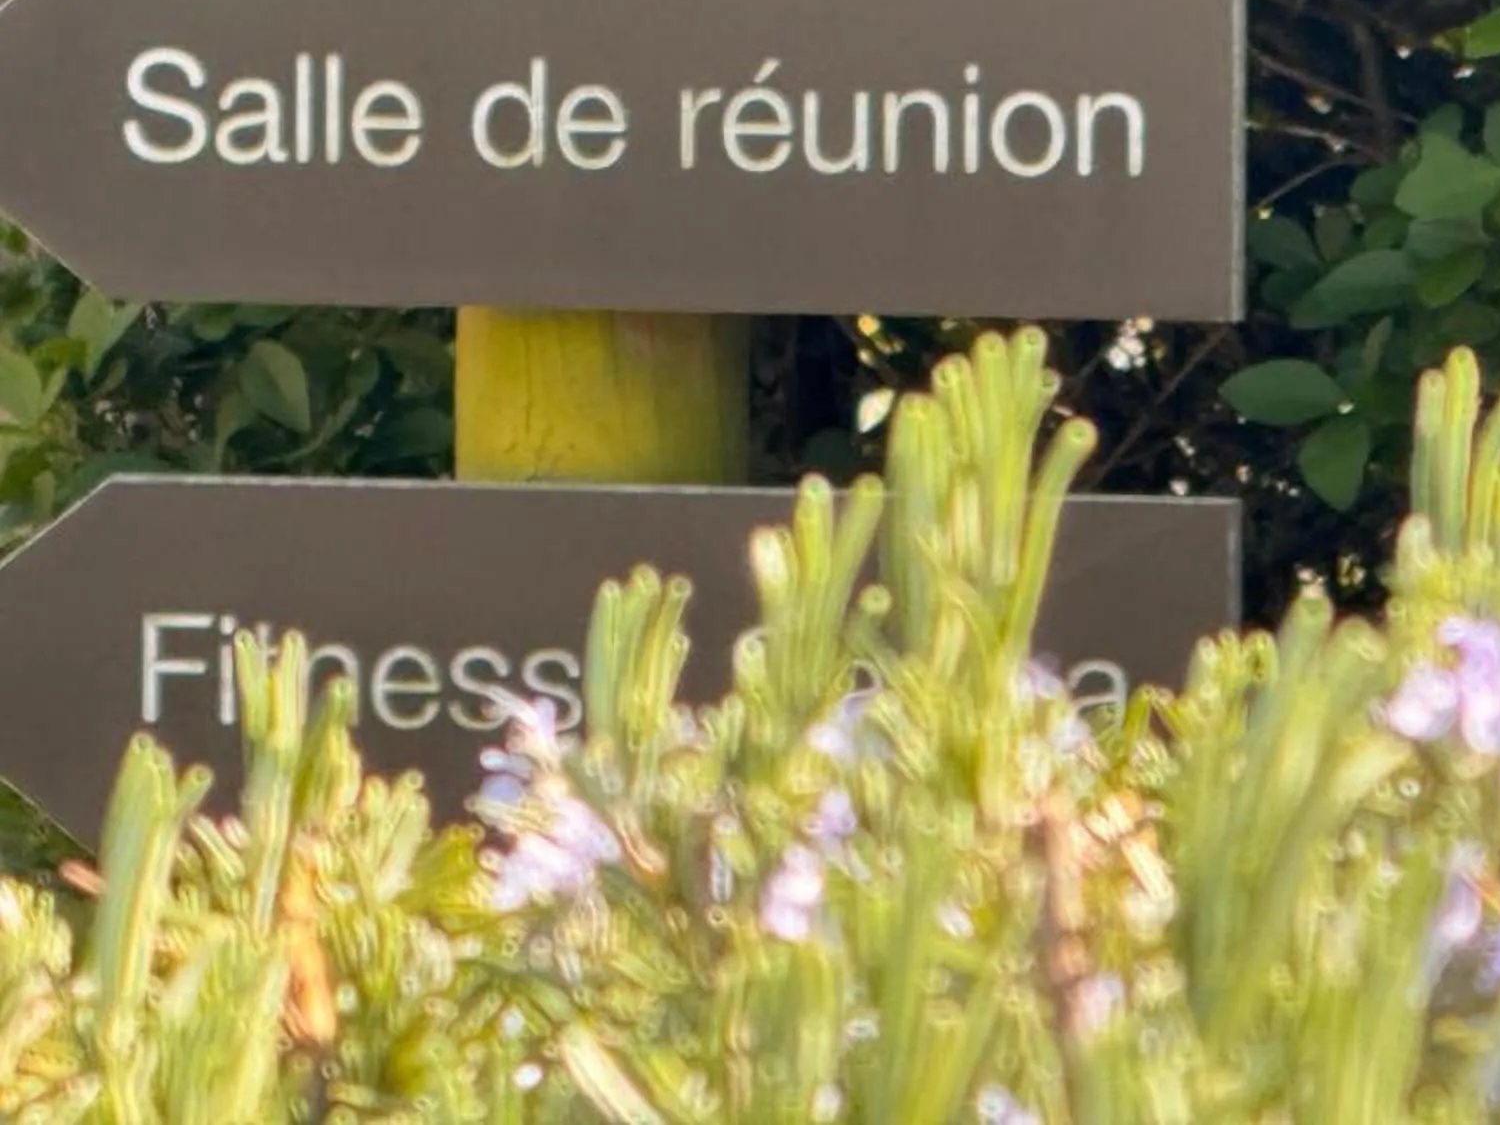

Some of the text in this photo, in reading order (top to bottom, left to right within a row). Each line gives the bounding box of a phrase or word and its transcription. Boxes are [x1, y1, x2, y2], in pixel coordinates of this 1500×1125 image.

[122, 46, 1146, 178] Salle de réunion
